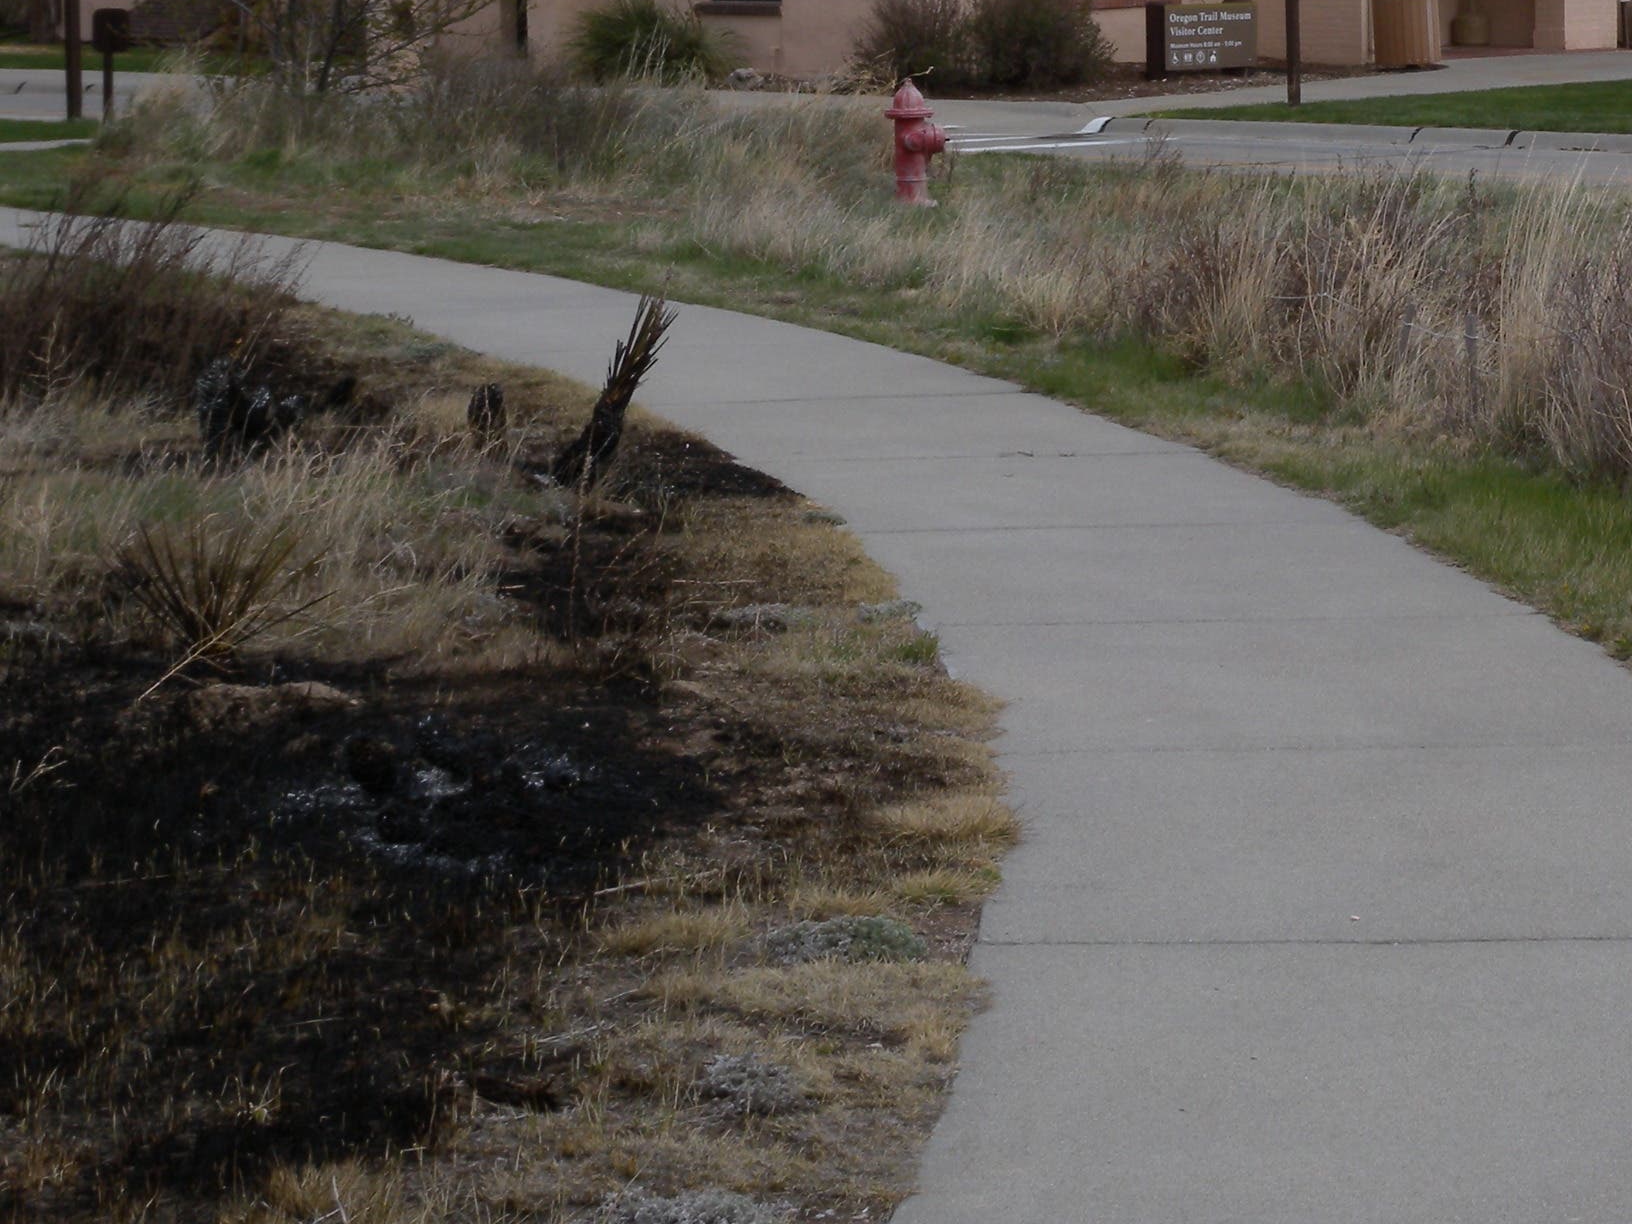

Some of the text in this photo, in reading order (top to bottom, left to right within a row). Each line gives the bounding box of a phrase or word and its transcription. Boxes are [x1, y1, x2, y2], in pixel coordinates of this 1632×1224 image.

[1169, 11, 1251, 24] Oregon Trail Museum
[1170, 25, 1224, 36] Visitor Center
